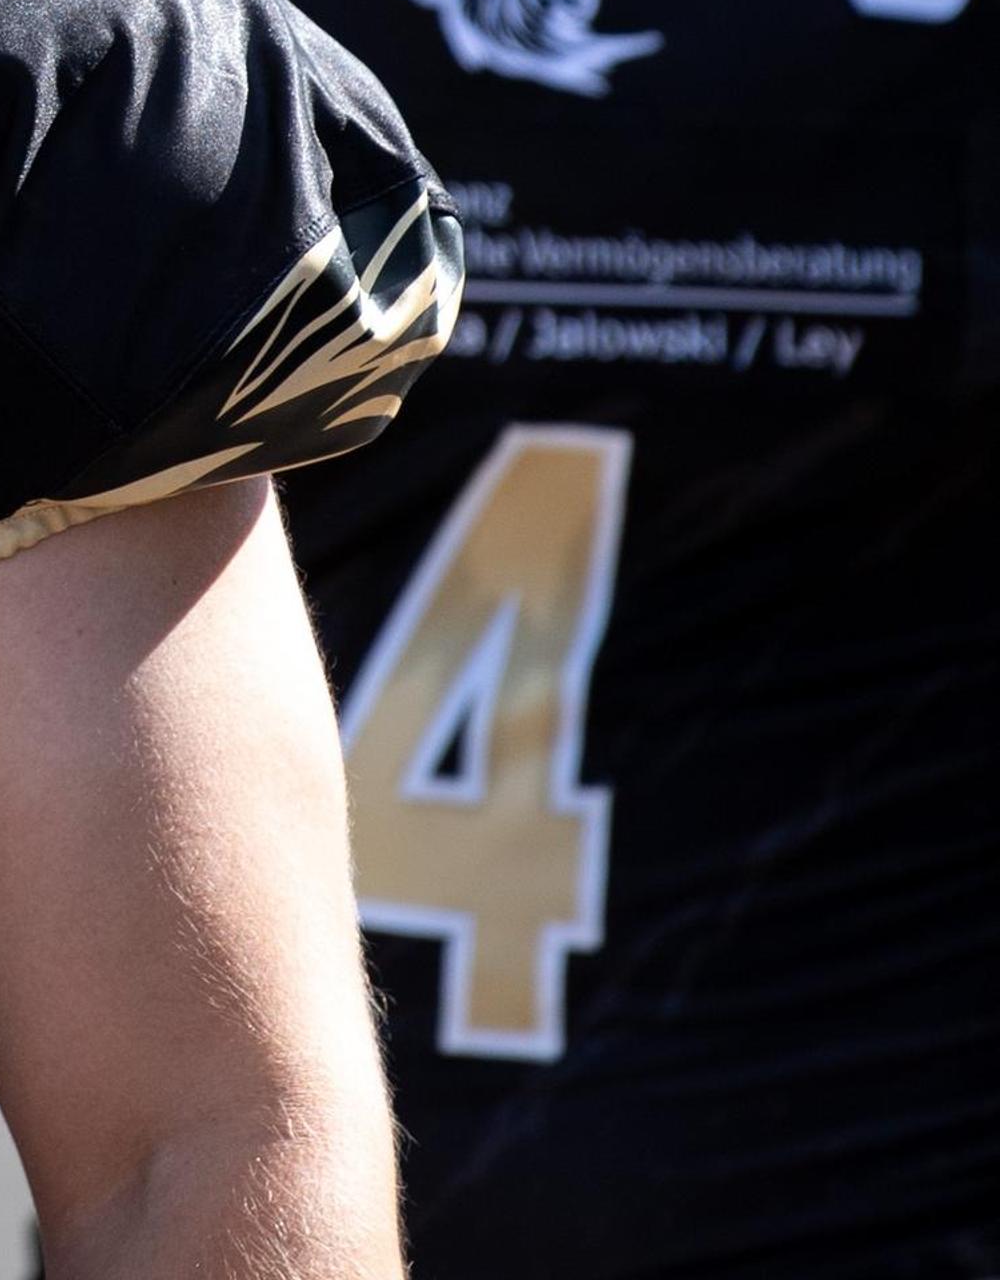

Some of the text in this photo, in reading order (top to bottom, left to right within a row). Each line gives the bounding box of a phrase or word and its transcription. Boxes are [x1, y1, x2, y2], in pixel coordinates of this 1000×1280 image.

[527, 308, 728, 361] Jalowski
[773, 316, 864, 377] Ley
[340, 421, 634, 1063] 4
